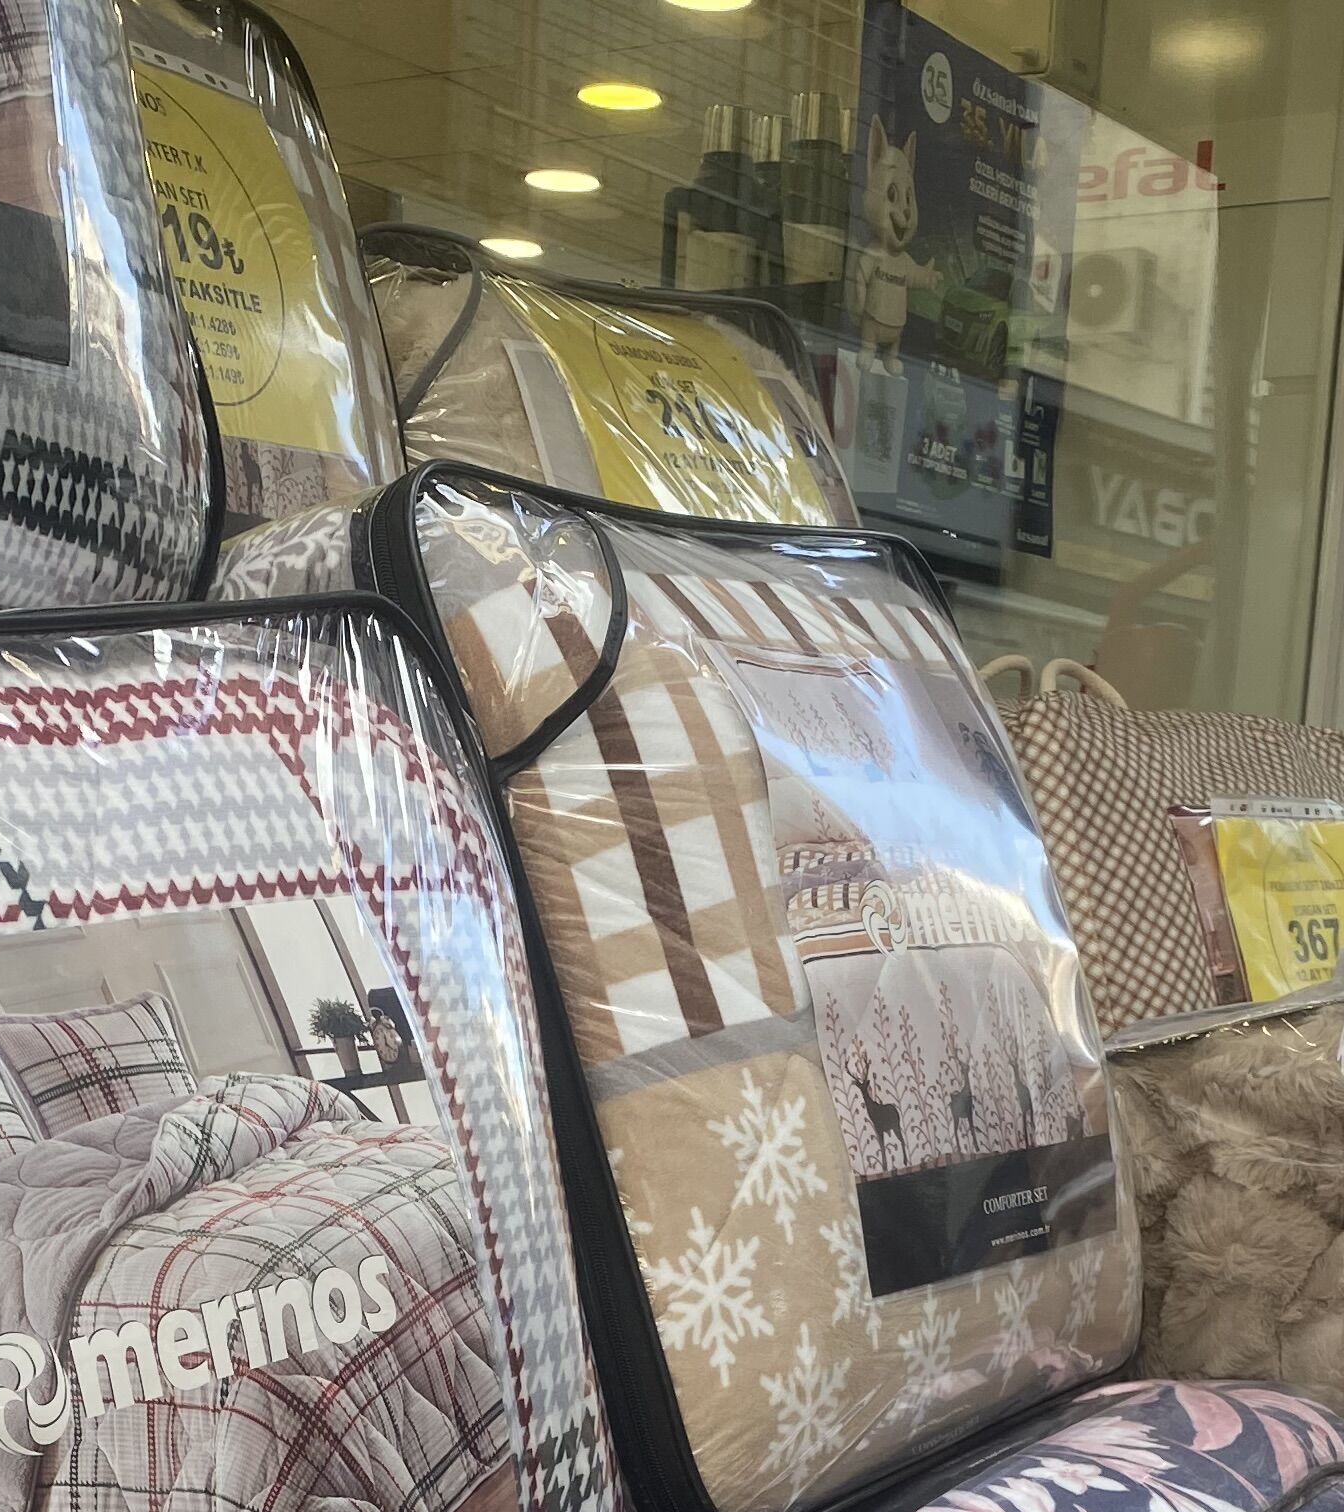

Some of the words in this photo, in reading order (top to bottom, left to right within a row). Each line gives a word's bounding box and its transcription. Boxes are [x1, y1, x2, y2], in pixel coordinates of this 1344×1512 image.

[179, 185, 211, 211] SETİ
[174, 276, 263, 314] TAKSİTLE
[930, 440, 958, 464] ADET
[983, 1190, 1034, 1215] COMFORTER
[1034, 1185, 1049, 1204] SET
[68, 1254, 397, 1420] merinos
